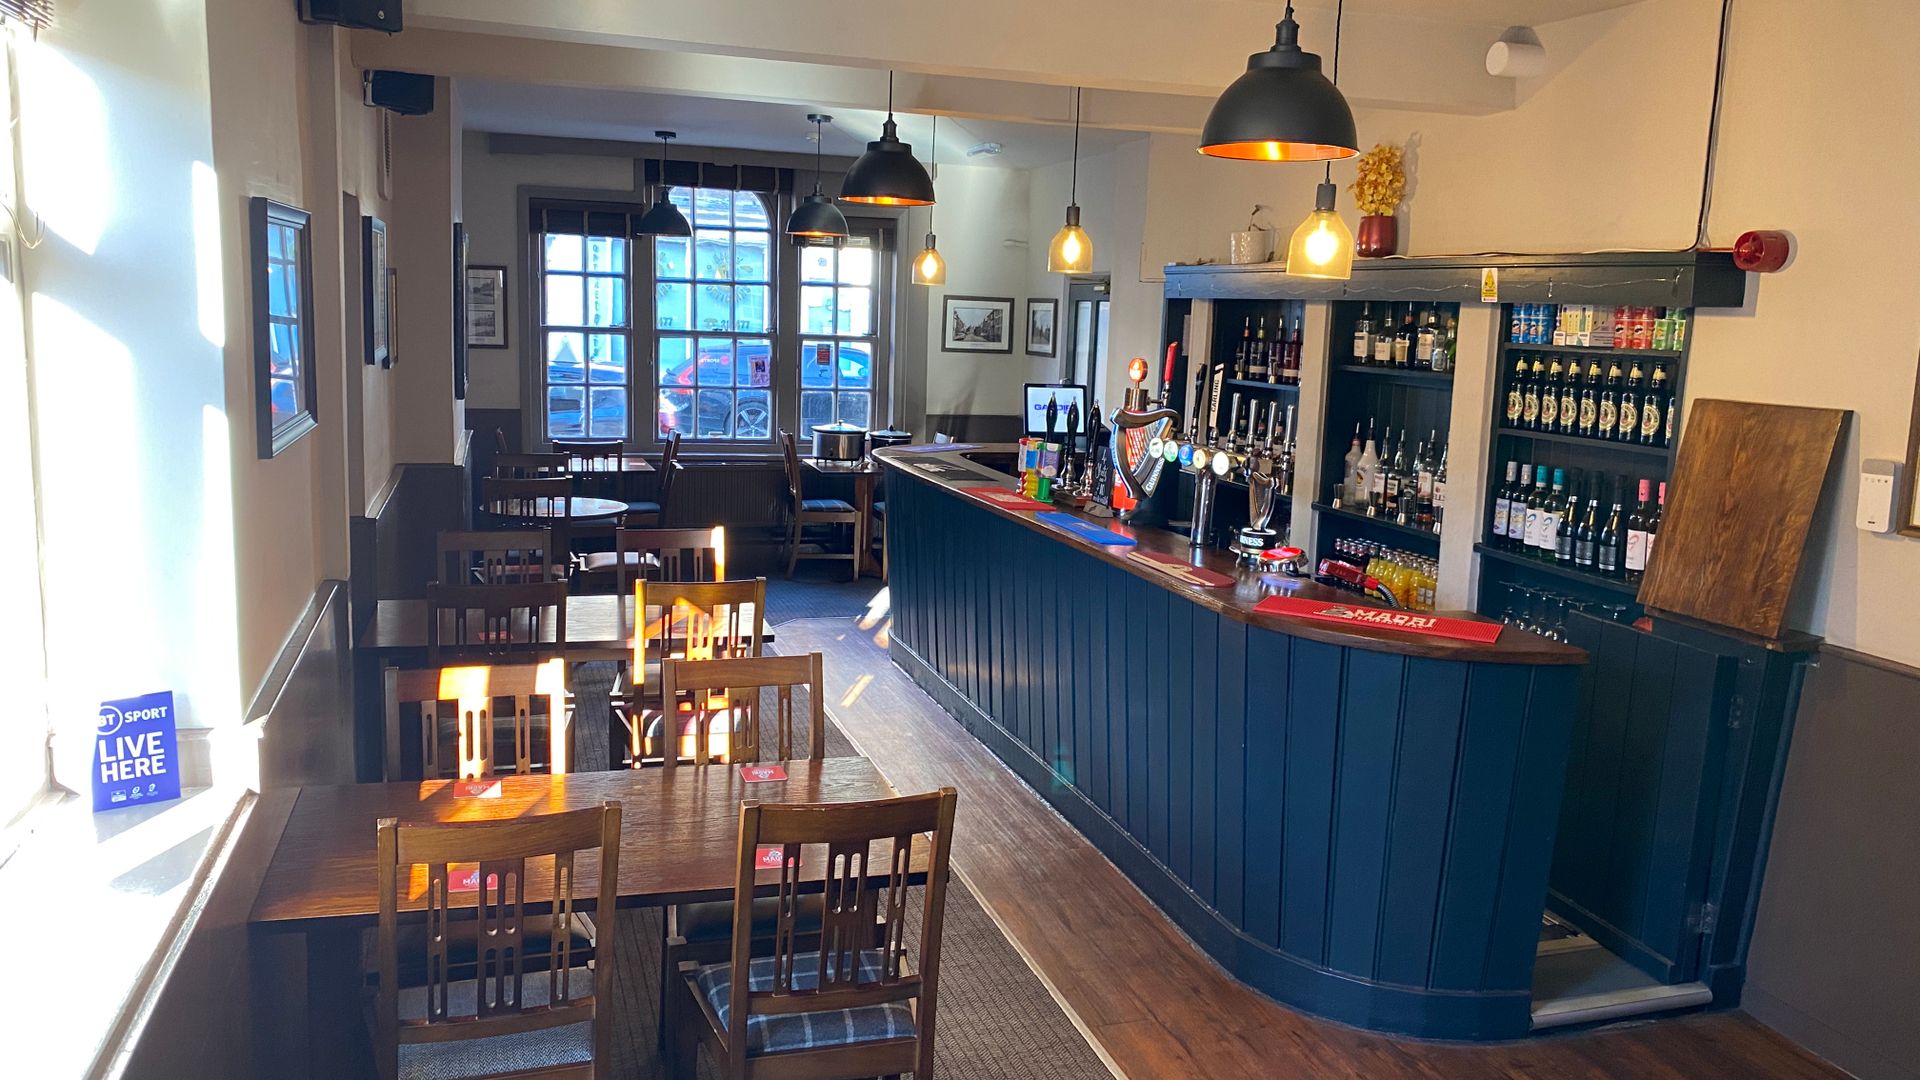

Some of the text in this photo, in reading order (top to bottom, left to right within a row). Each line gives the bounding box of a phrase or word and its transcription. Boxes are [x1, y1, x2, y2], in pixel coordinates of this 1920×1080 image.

[1145, 457, 1165, 492] GUINNESS
[124, 706, 168, 723] SPORT
[98, 731, 164, 763] LIVE
[100, 754, 166, 784] HERE
